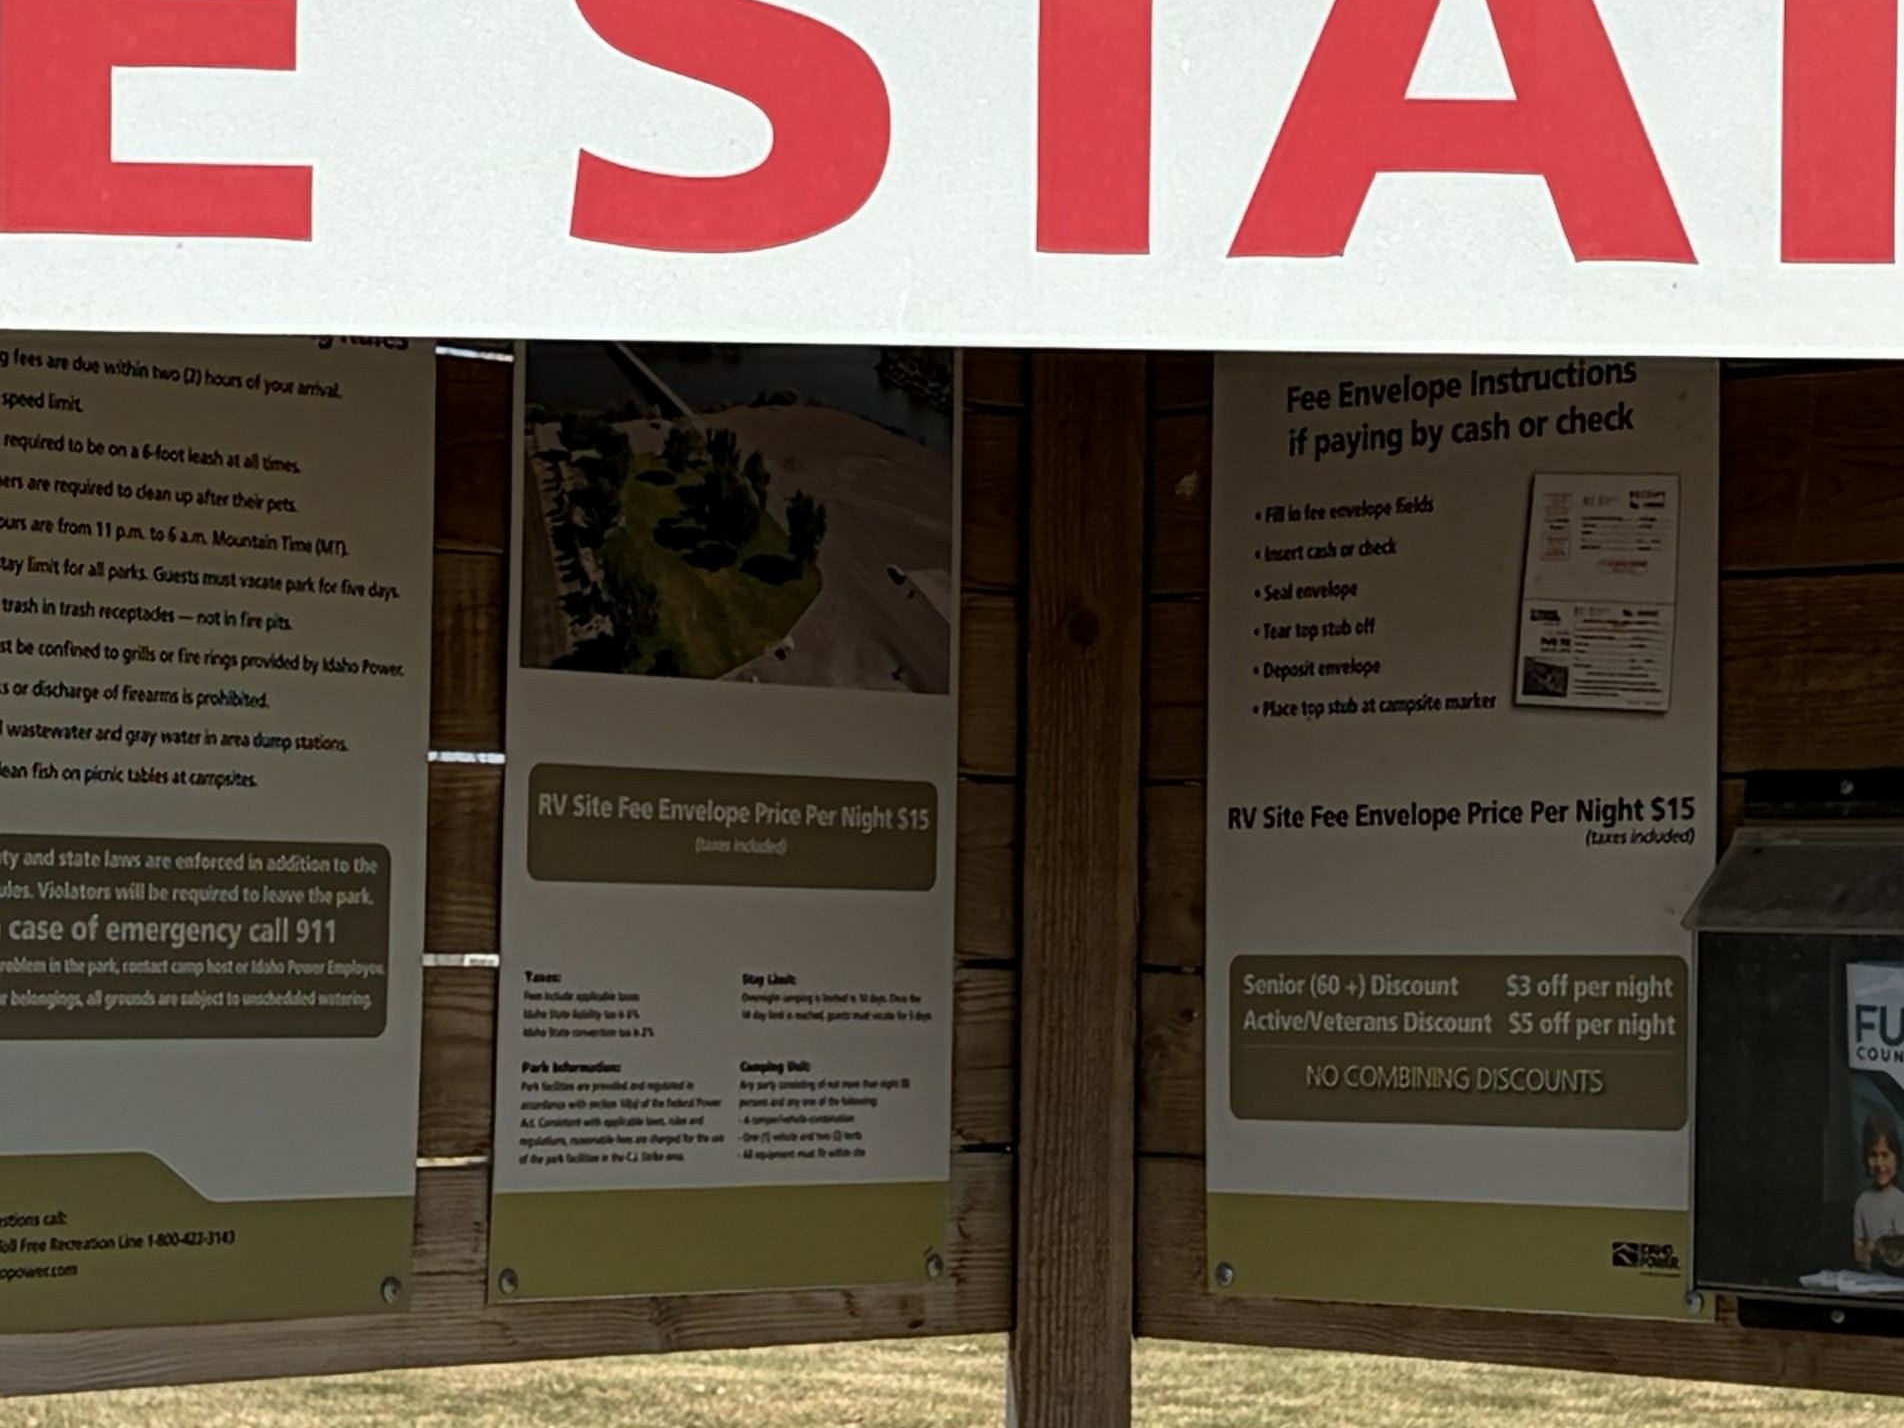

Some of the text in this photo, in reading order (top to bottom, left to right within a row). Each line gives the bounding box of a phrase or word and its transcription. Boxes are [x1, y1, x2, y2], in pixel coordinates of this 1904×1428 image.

[1287, 359, 1637, 413] Fee Envelope Instructions
[1, 391, 44, 410] speed
[48, 391, 83, 413] limit.
[1289, 400, 1633, 462] if paying by cash or check
[3, 433, 65, 453] required
[68, 437, 83, 454] to
[86, 436, 105, 456] be
[108, 443, 127, 458] on
[130, 445, 139, 460] a
[142, 442, 184, 464] 6-foot
[188, 446, 223, 466] leash
[226, 453, 239, 468] at
[243, 452, 258, 470] all
[262, 454, 300, 474] times.
[1265, 493, 1434, 524] Fill in fee envelope fields
[1264, 536, 1396, 562] Insert cash or check
[1264, 579, 1358, 602] Seal envelope
[1263, 616, 1375, 642] Tear top stub off
[1263, 656, 1381, 682] Deposit envelope
[12, 682, 28, 697] or
[32, 679, 99, 704] discharge
[102, 683, 119, 701] of
[122, 683, 179, 704] firearms
[182, 686, 193, 705] is
[196, 688, 269, 709] prohibited.
[1262, 691, 1496, 718] Place top stub at campsite marker
[538, 792, 929, 834] RV Site Fee Envelope Price Per Night $15
[1228, 795, 1695, 831] RV Site Fee Envelope Price Per Night $15
[1585, 826, 1695, 847] (taxes included)
[23, 847, 55, 867] and
[59, 850, 101, 868] state
[104, 848, 141, 868] laws
[145, 854, 171, 870] are
[175, 850, 244, 871] enforced
[248, 852, 263, 871] in
[266, 854, 330, 872] addition
[333, 857, 349, 874] to
[353, 855, 377, 874] the
[37, 879, 111, 901] Violators
[115, 881, 145, 901] will
[148, 882, 168, 901] be
[172, 883, 239, 906] required
[242, 886, 259, 903] to
[262, 884, 304, 904] leave
[308, 885, 333, 905] the
[336, 886, 372, 909] park.
[9, 919, 63, 941] case
[71, 913, 99, 941] of
[106, 920, 241, 950] emergency
[249, 916, 288, 943] call
[296, 917, 335, 944] 911
[1244, 972, 1458, 999] Senior (60 +) Discount
[1507, 973, 1672, 1004] $3 off per night
[1243, 1010, 1491, 1034] Active/Veterans Discount
[1509, 1012, 1675, 1041] $5 off per night
[1306, 1063, 1602, 1093] NO COMBINING DISCOUNTS
